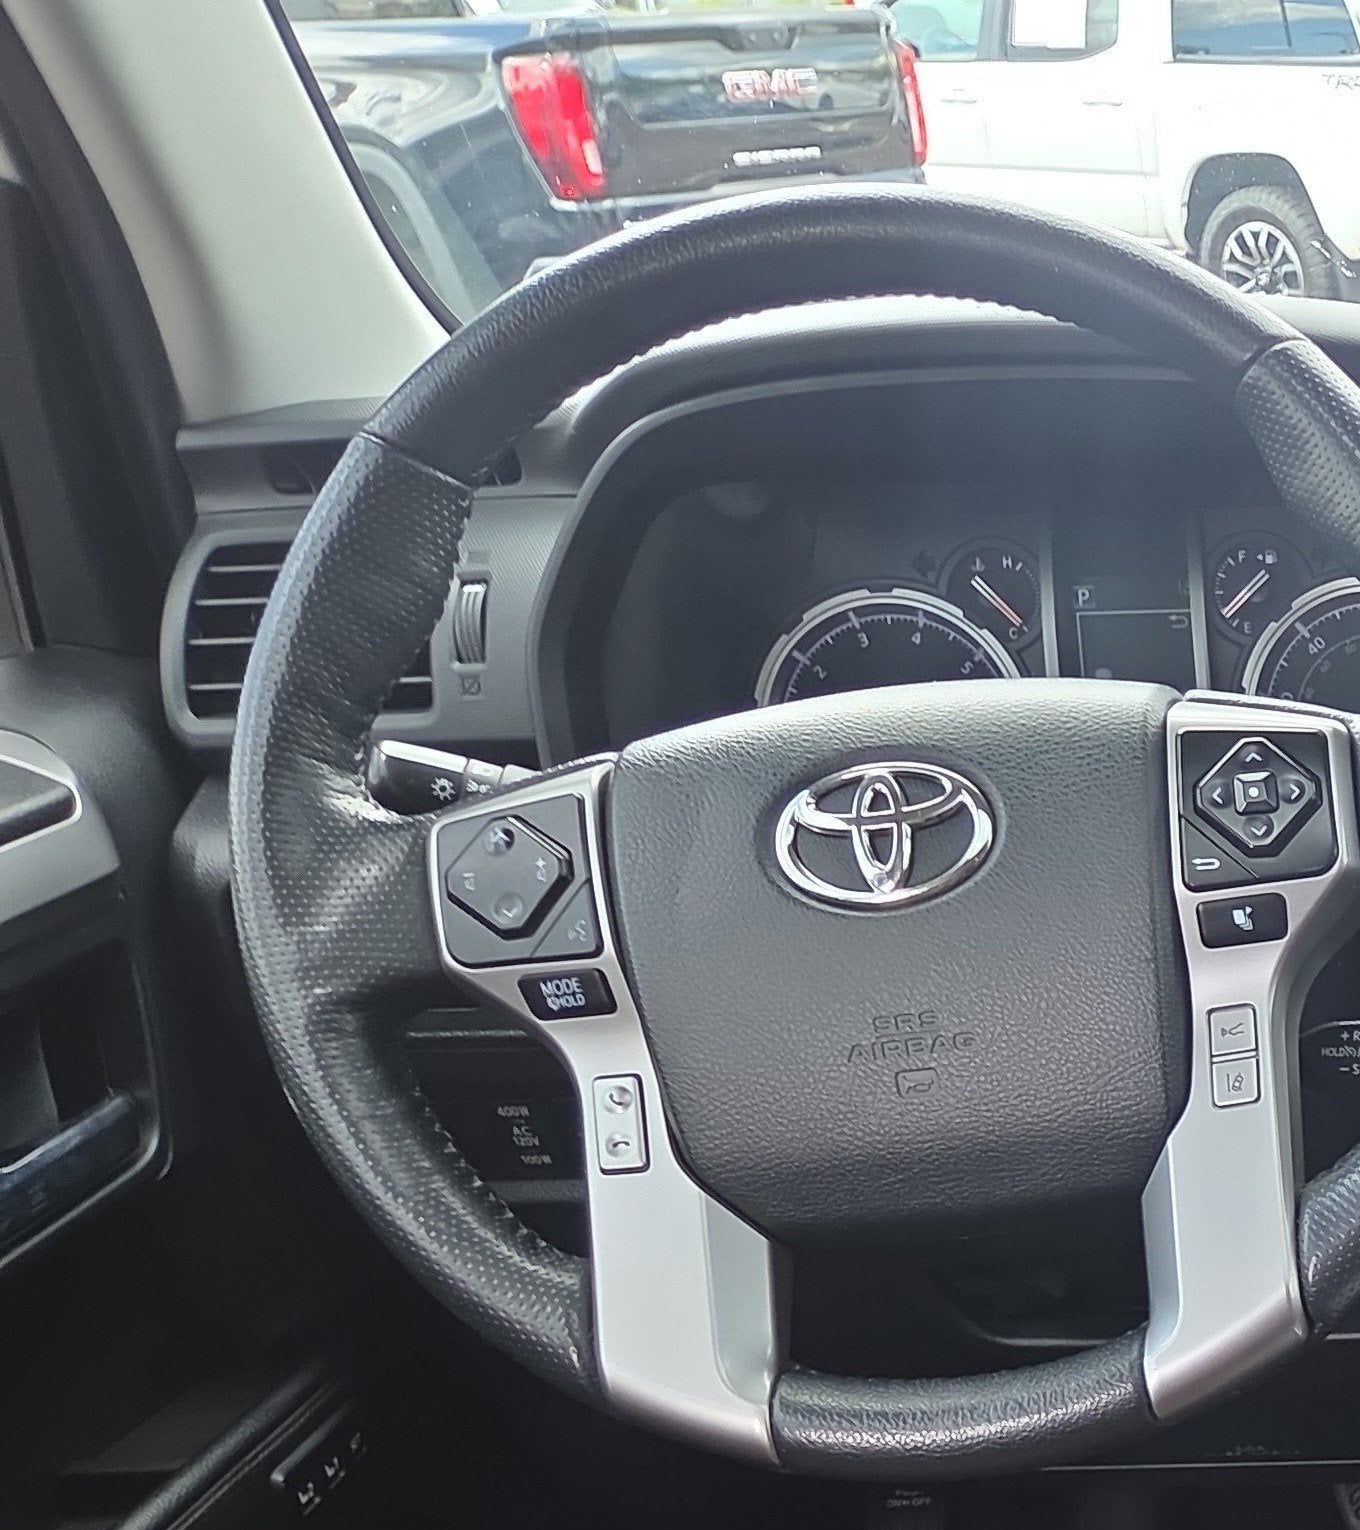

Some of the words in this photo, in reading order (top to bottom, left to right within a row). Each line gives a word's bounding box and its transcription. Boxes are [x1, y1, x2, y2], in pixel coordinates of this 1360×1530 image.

[722, 68, 818, 101] GMC
[1078, 588, 1089, 606] P
[858, 632, 869, 648] 3
[911, 632, 921, 645] 4
[1308, 636, 1326, 655] 40
[814, 665, 827, 680] 2
[960, 660, 974, 675] 5
[540, 977, 583, 996] MODE
